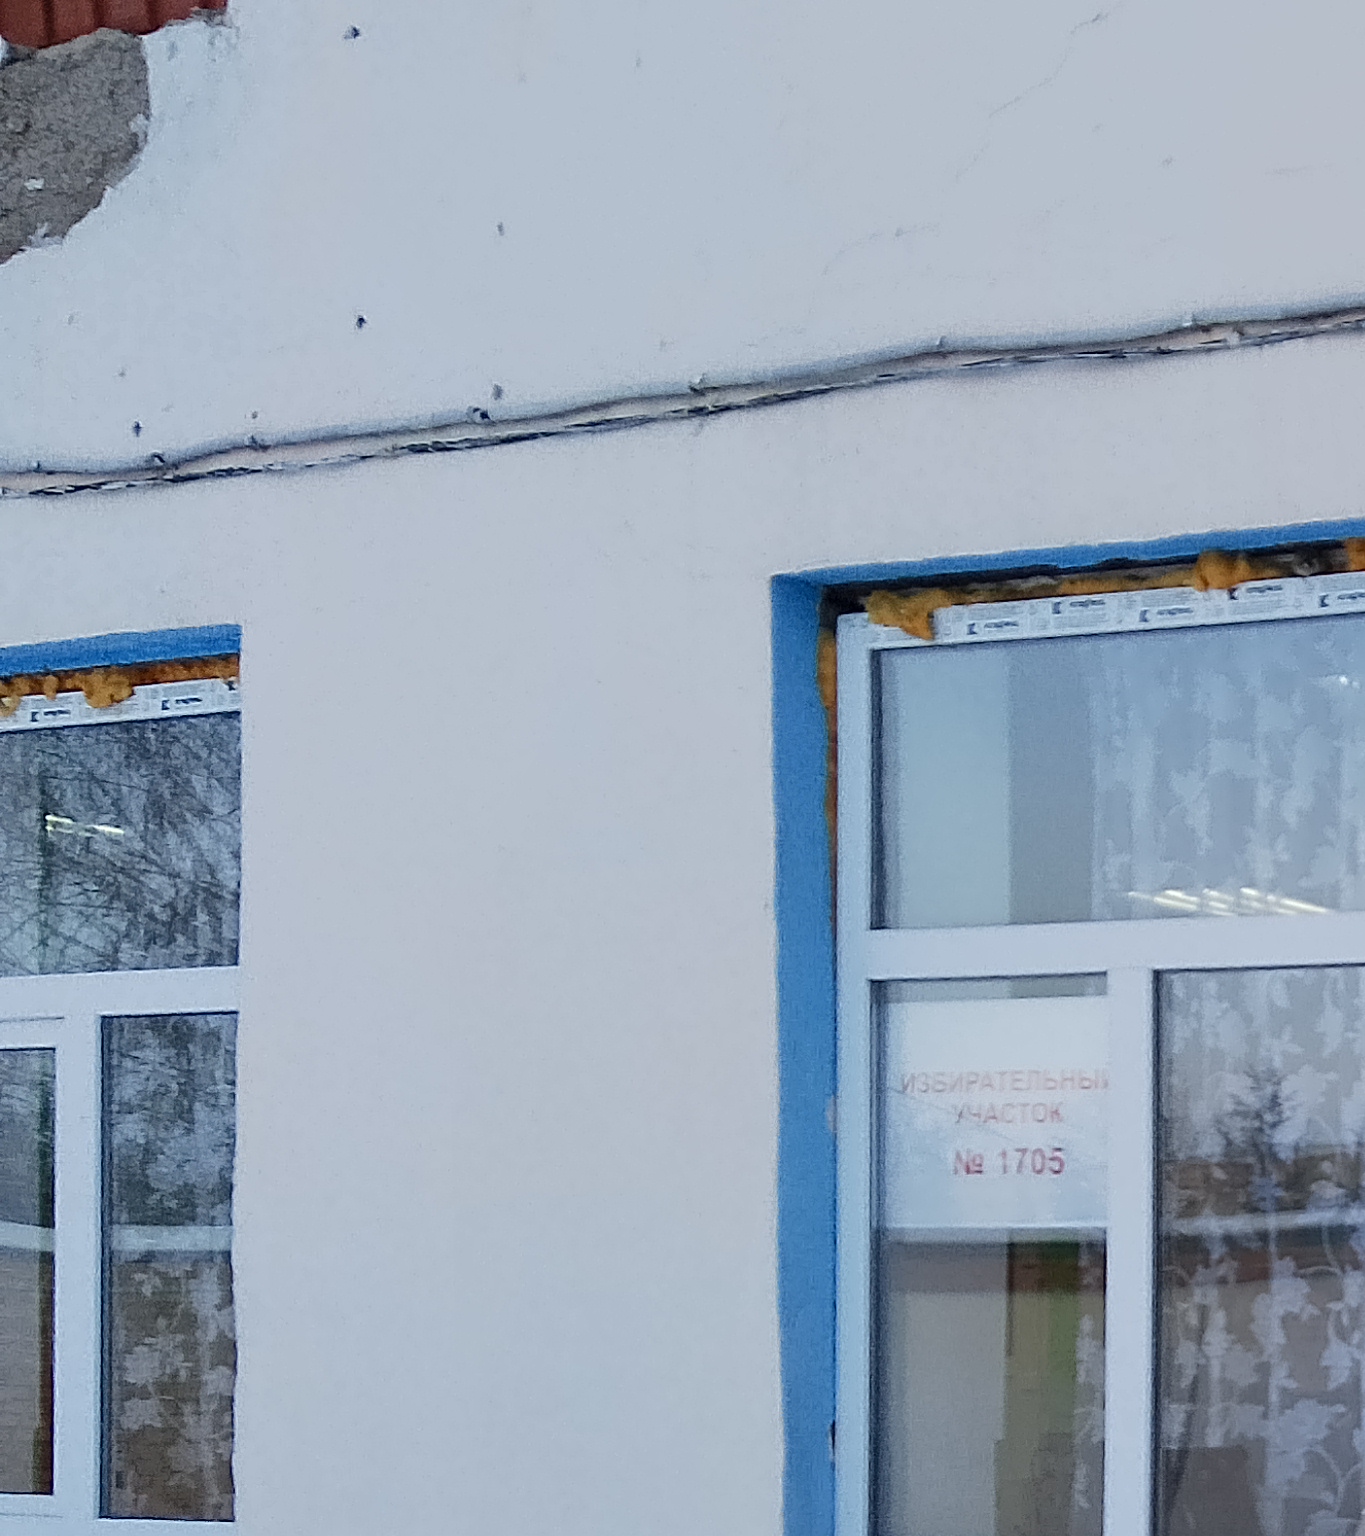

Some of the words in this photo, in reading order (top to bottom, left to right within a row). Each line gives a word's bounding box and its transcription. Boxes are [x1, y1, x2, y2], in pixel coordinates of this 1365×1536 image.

[954, 1101, 1064, 1124] УЧАСТОК
[954, 1150, 984, 1175] №
[998, 1147, 1066, 1175] 1705
